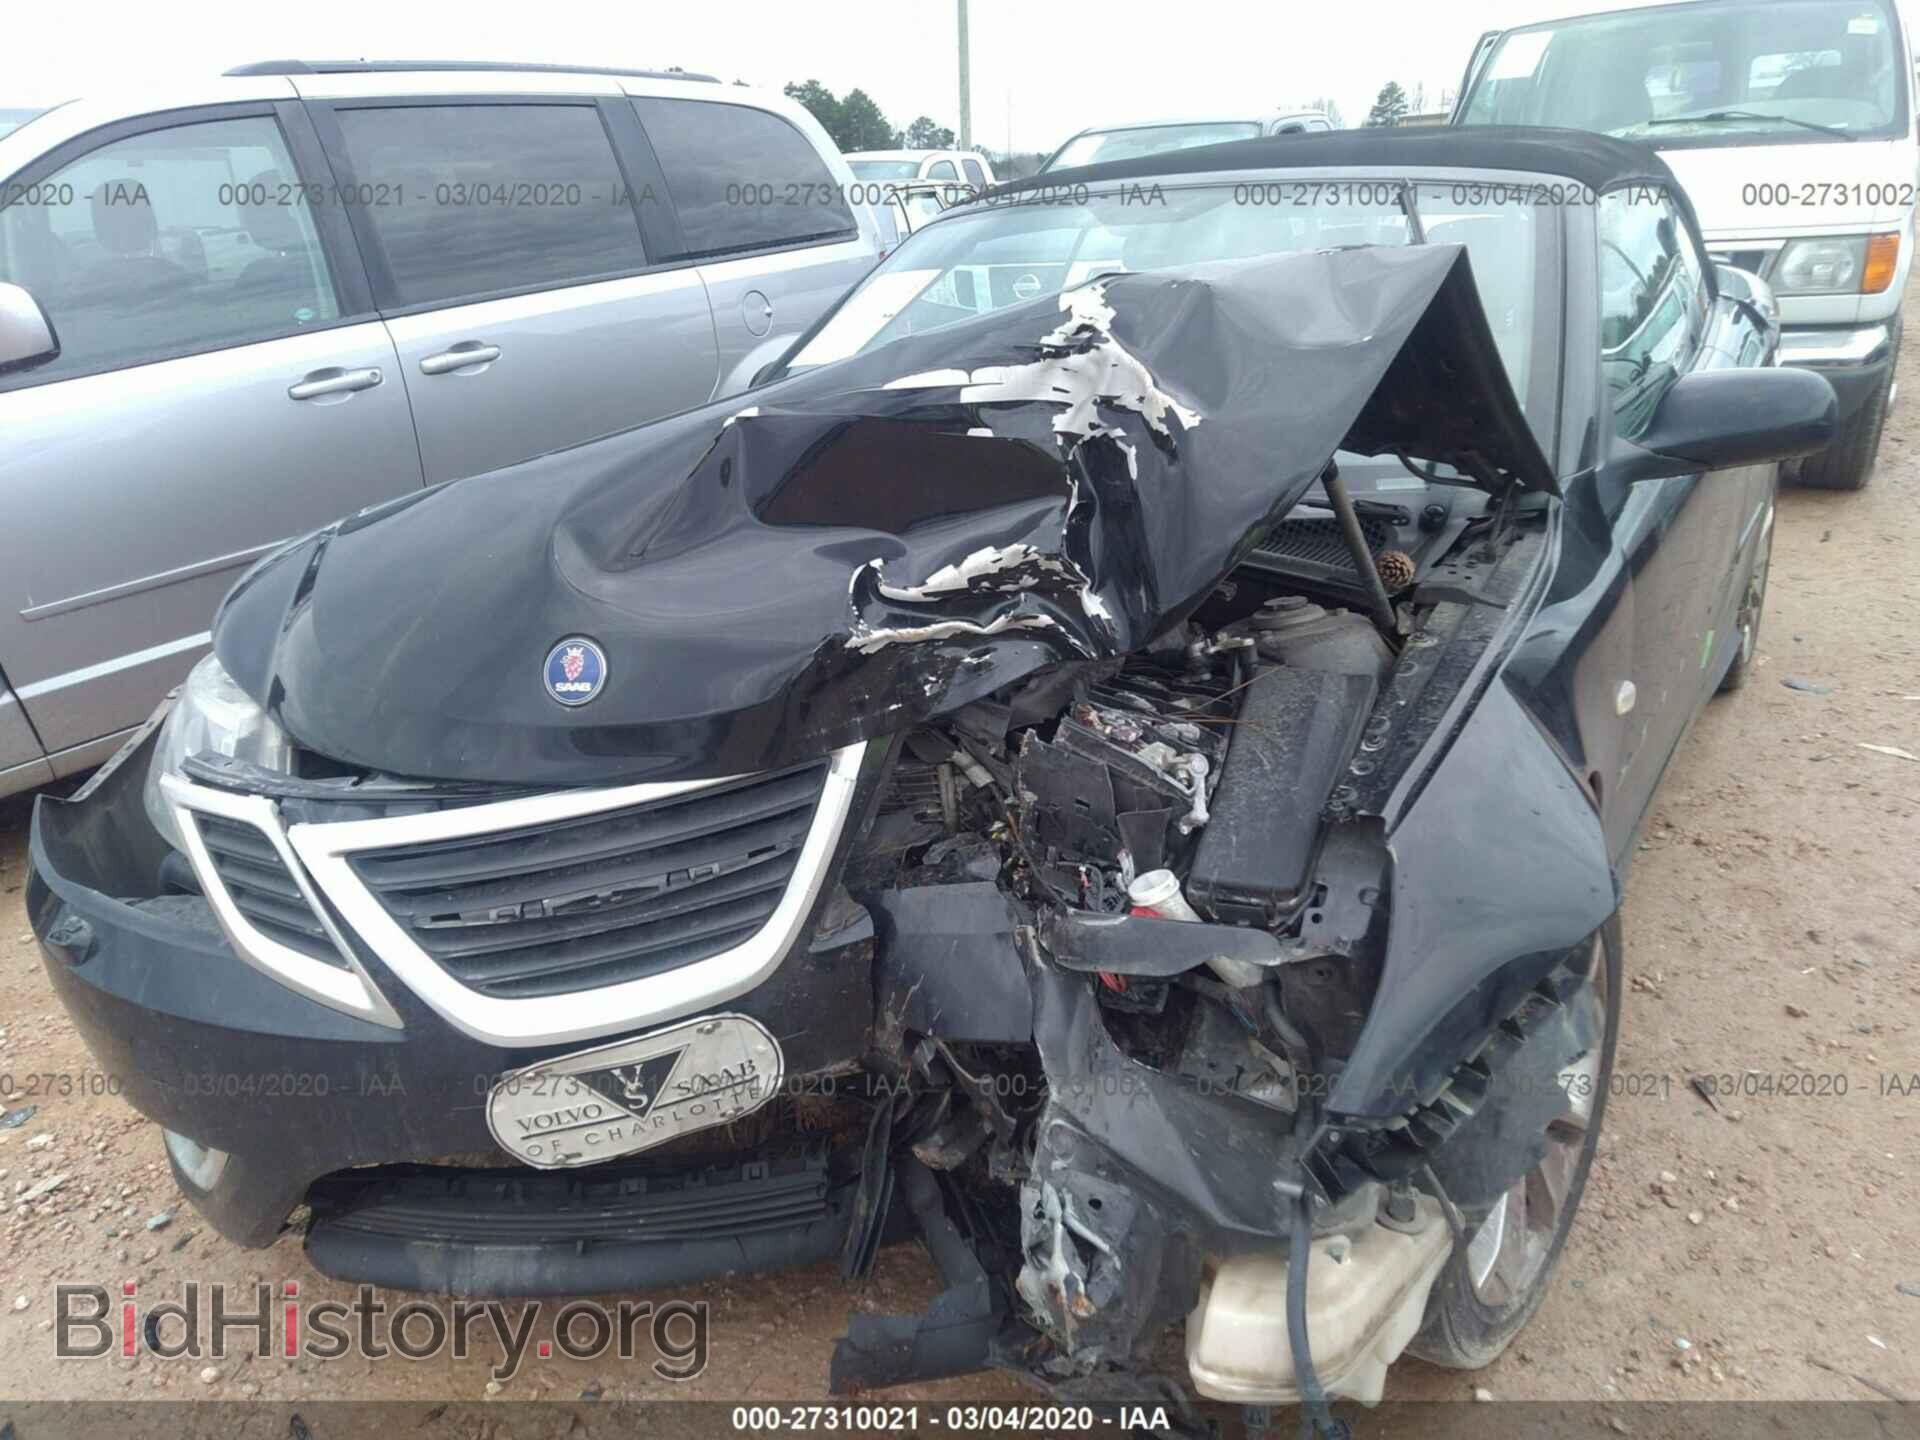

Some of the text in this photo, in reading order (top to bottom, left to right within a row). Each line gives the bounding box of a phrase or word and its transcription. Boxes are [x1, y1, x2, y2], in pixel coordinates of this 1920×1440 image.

[555, 682, 592, 692] SAAB
[516, 1059, 757, 1132] VOLVO SAAB
[527, 1088, 763, 1157] OF CHARLOTTE
